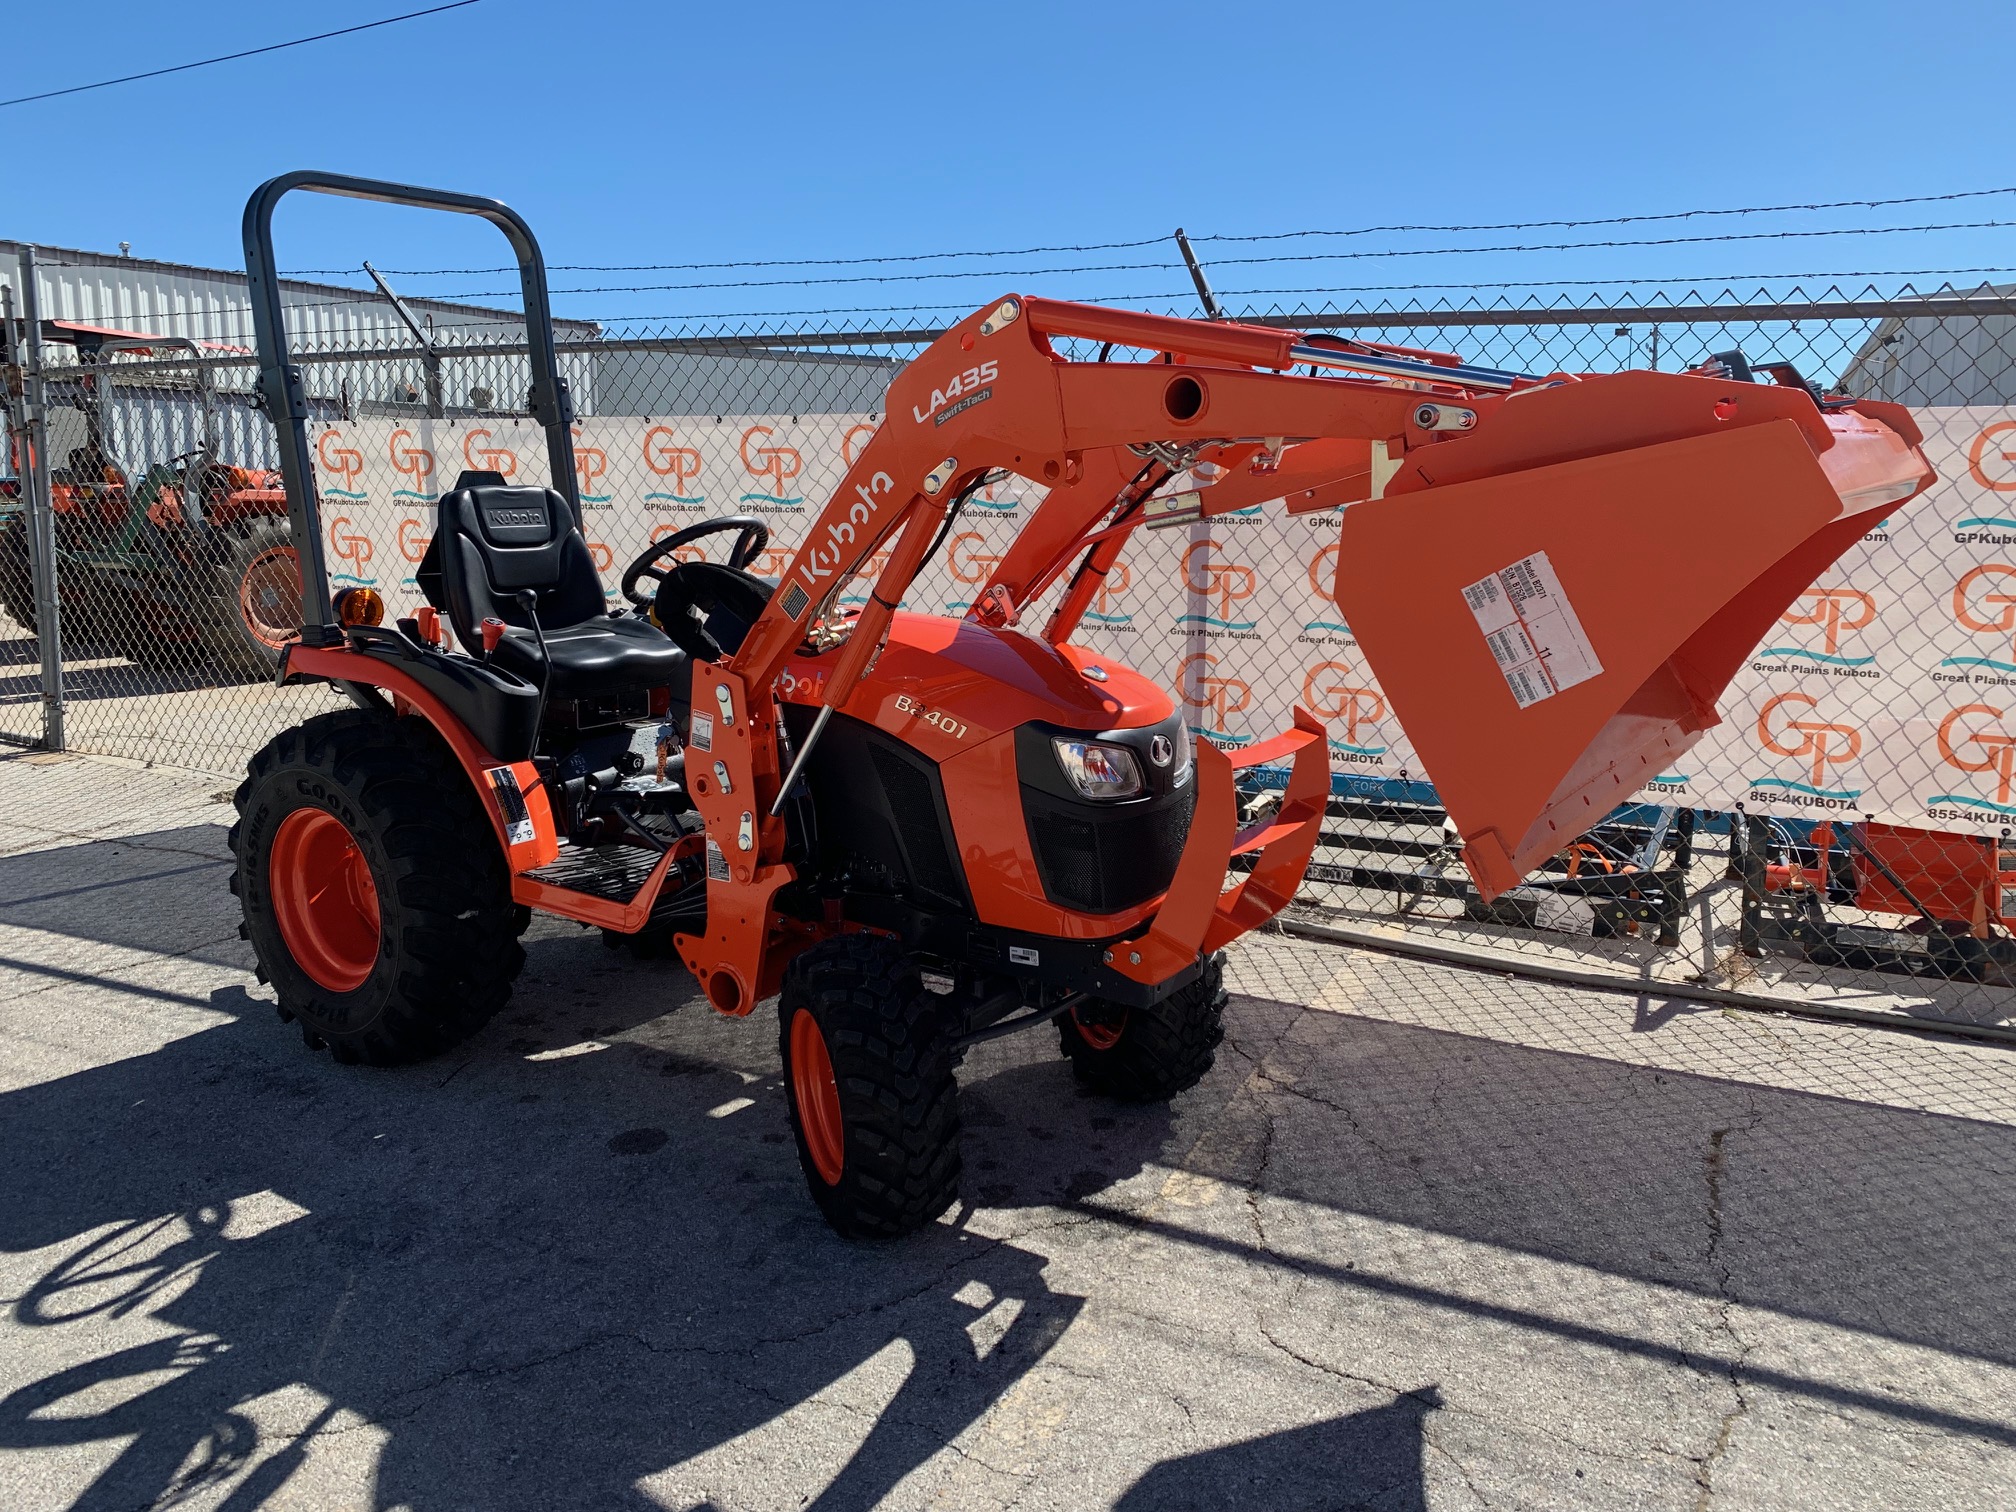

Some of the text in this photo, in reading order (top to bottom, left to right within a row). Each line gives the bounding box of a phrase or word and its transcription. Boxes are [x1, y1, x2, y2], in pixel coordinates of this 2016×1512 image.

[912, 359, 999, 424] LA435
[936, 390, 990, 425] Swift-Tach
[318, 429, 363, 492] GP
[389, 429, 434, 493] GP
[643, 425, 702, 496] GP
[739, 425, 802, 497] GP
[325, 498, 370, 506] GPKubota.com
[489, 510, 542, 525] Kubota
[644, 503, 706, 512] GPKubota.com
[739, 504, 805, 514] GPKubota.com
[960, 508, 1018, 519] Kubota.com
[799, 471, 895, 585] Kubota
[330, 517, 373, 577] GP
[1180, 539, 1256, 620] GP
[1504, 566, 1528, 602] S/N B7528
[1521, 558, 1548, 599] Model B2371
[1104, 623, 1136, 633] Kubota
[1170, 627, 1262, 640] Great Plains Kubota
[1298, 635, 1357, 647] Great Plains
[1753, 662, 1881, 679] Great Plains Kubota
[1932, 672, 1971, 684] Great
[1174, 652, 1251, 732] GP
[1303, 661, 1386, 744] GP
[894, 694, 968, 739] B2401
[1758, 692, 1862, 786] GP
[1354, 780, 1386, 793] FORK
[1750, 791, 1858, 811] 855-4KUBOTA
